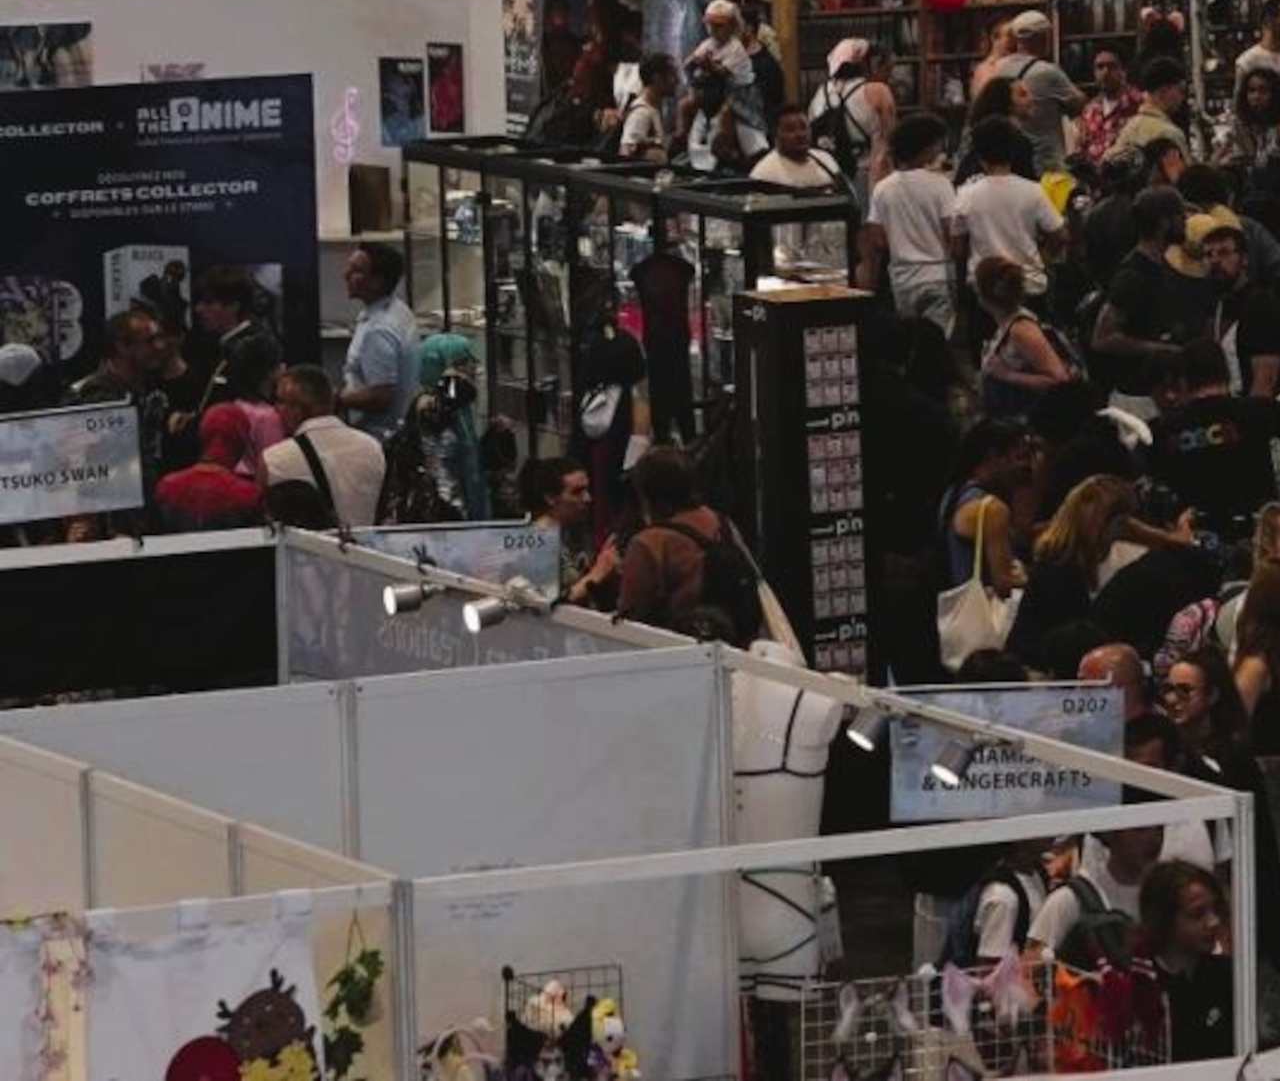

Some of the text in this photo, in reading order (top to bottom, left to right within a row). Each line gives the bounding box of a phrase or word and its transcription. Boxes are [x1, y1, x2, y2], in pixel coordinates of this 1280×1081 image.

[137, 107, 170, 120] ALL
[138, 97, 283, 133] THE ANIME
[25, 180, 259, 207] COFFRETS COLLECTOR
[60, 463, 110, 486] SWAN
[1062, 697, 1109, 715] D207
[921, 775, 936, 792] &
